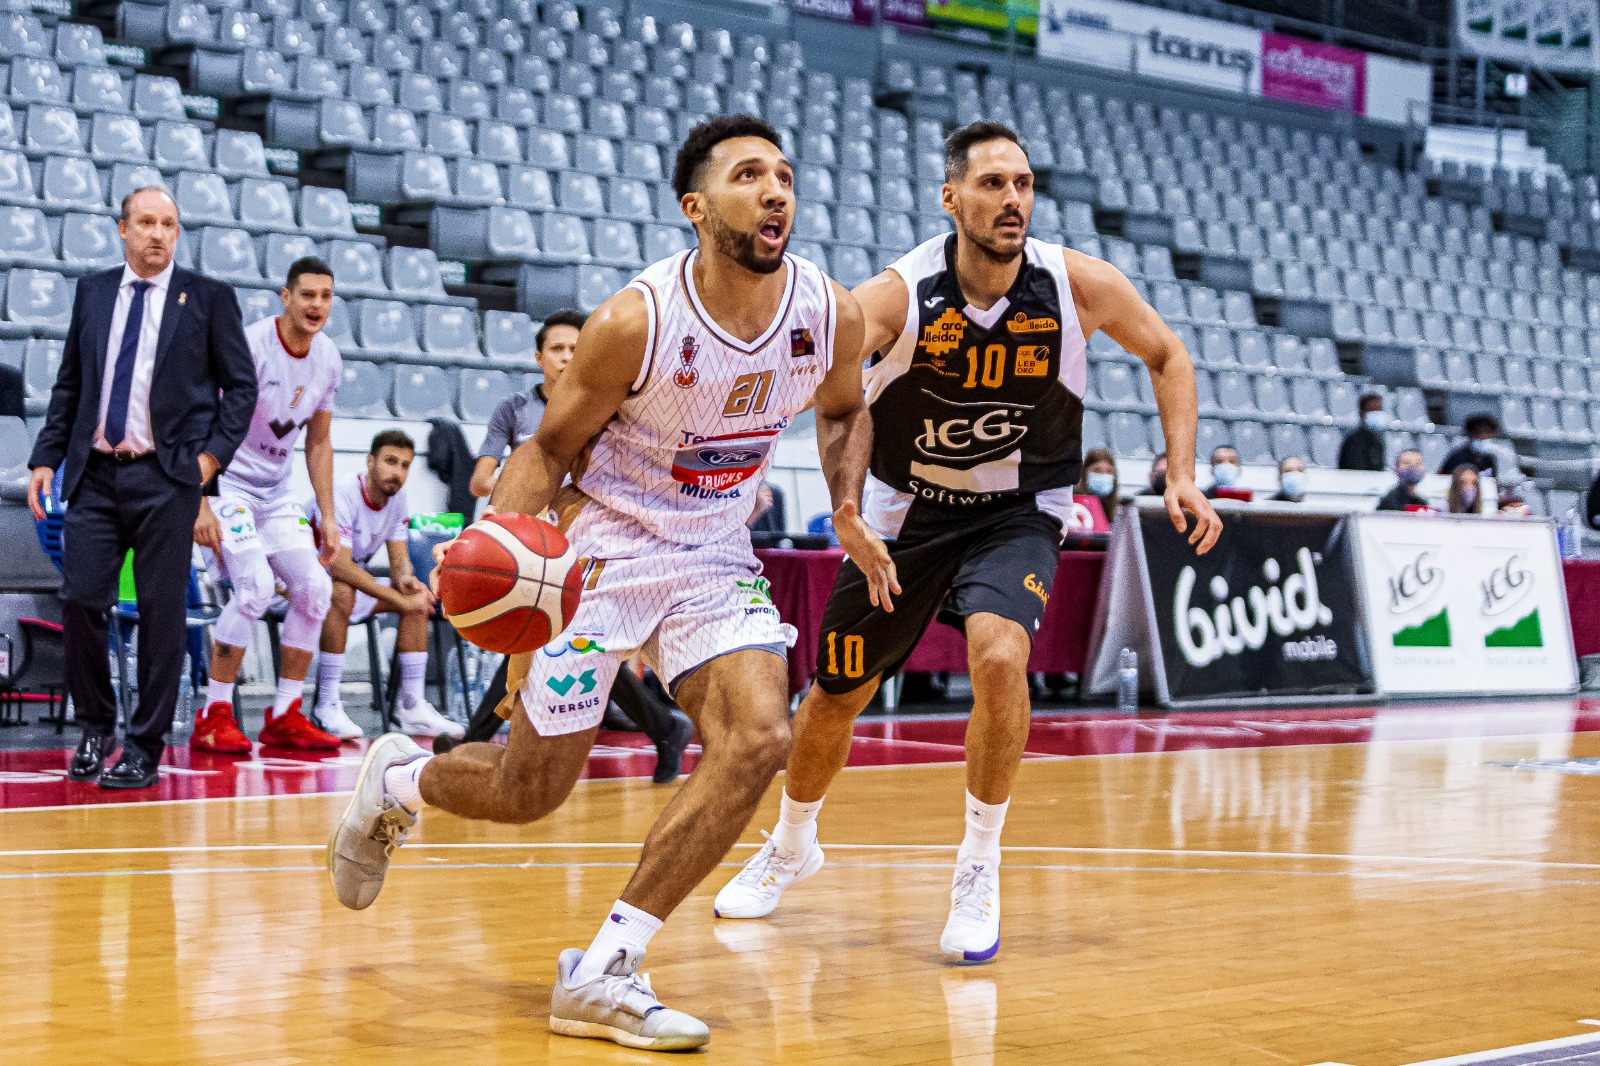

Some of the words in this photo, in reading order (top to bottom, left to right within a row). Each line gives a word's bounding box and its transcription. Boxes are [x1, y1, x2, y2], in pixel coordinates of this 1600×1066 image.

[1147, 28, 1254, 74] taurus
[925, 331, 957, 343] lleida
[941, 320, 962, 331] ara
[963, 344, 1006, 388] 10
[722, 369, 776, 418] 21
[924, 409, 1011, 448] ICG
[697, 472, 743, 488] TRUCKS
[909, 480, 1020, 506] Softwa
[827, 631, 865, 678] 10
[1283, 635, 1337, 660] mobile
[548, 697, 600, 714] VERSUS
